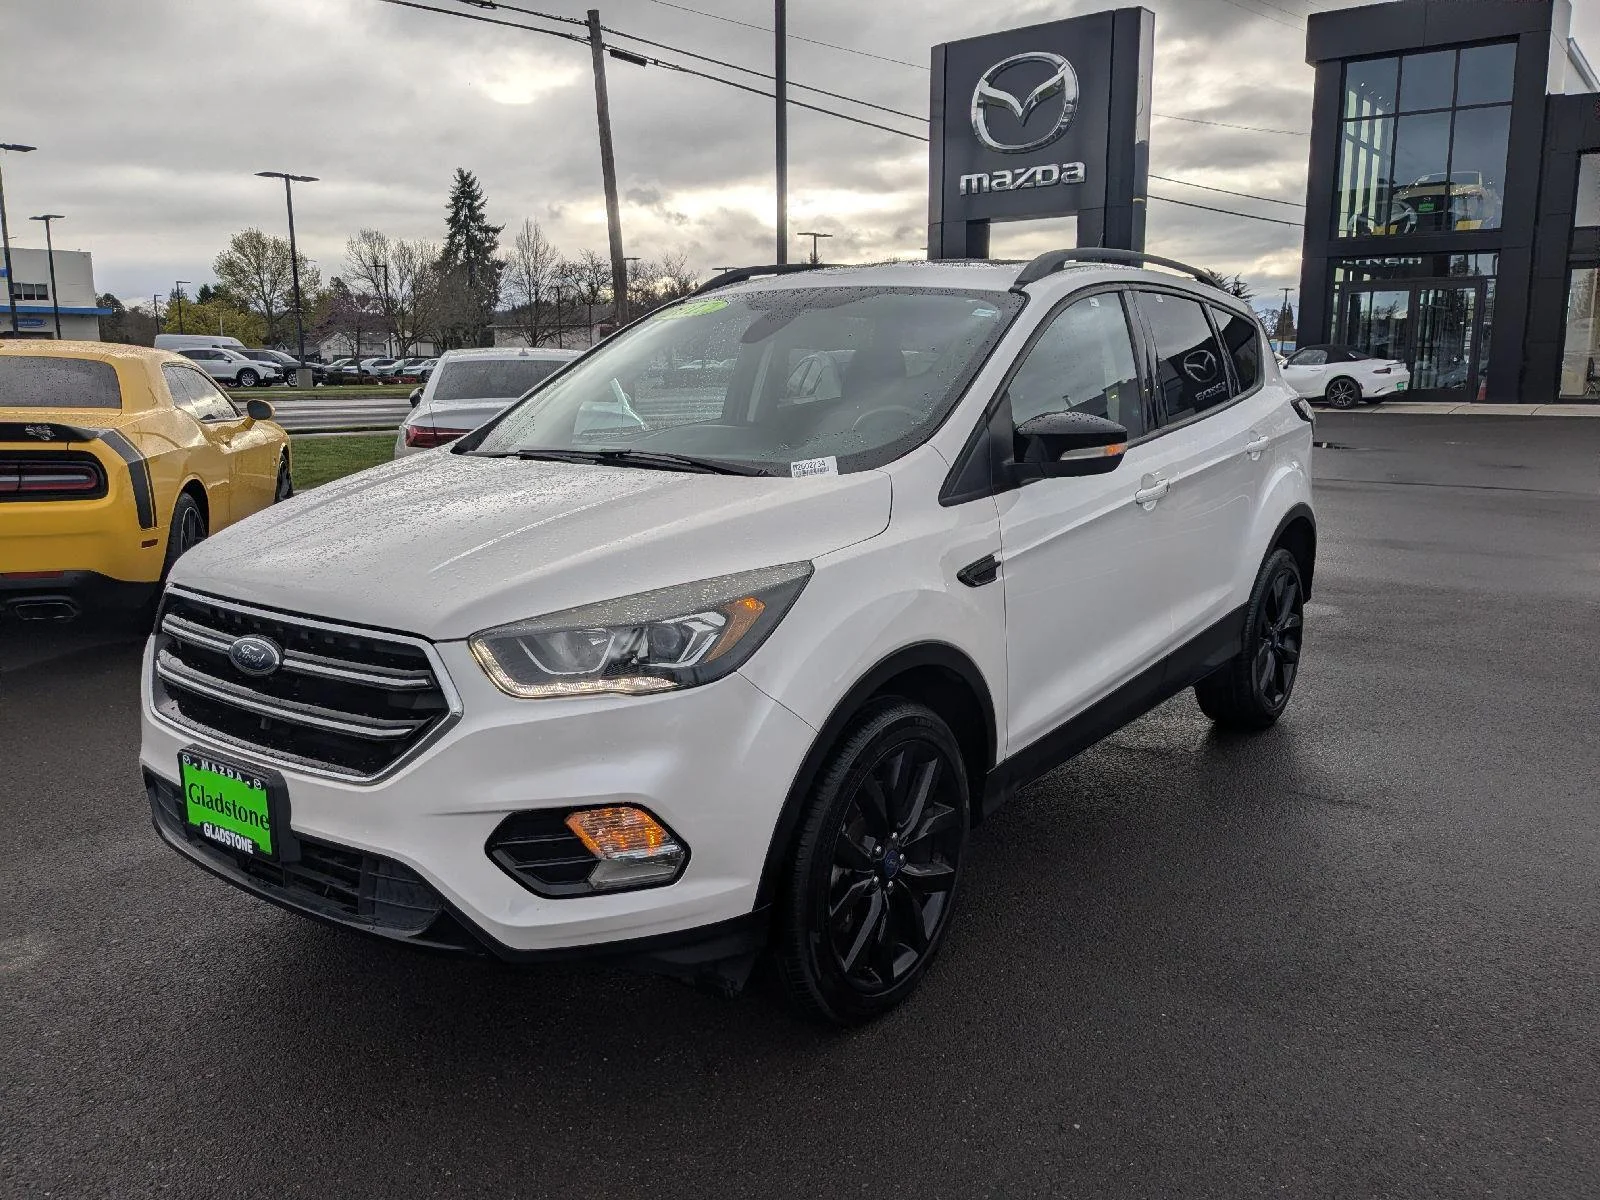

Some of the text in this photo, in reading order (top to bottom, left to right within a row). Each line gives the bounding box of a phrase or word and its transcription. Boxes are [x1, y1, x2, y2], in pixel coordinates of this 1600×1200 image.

[201, 760, 243, 782] MAZDA
[188, 783, 270, 830] Gladstone
[203, 822, 254, 854] GLADSTONE
